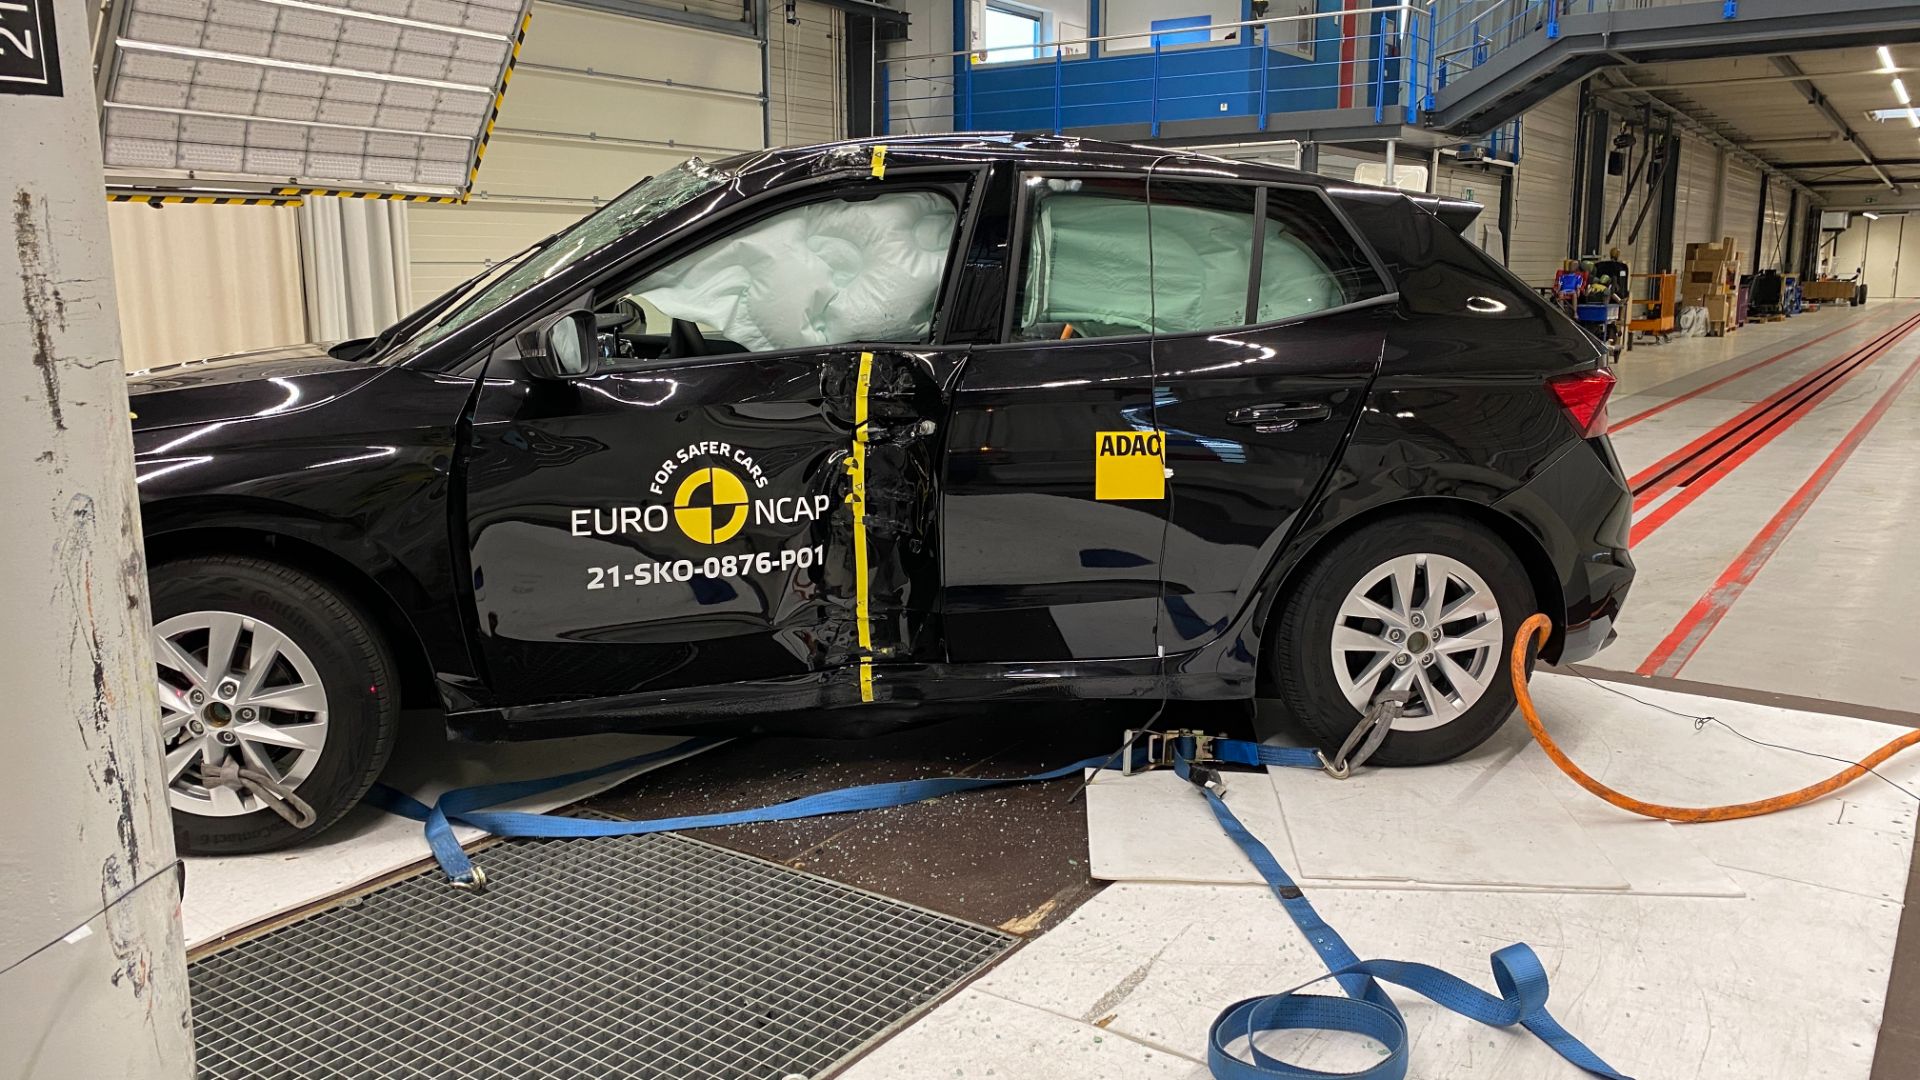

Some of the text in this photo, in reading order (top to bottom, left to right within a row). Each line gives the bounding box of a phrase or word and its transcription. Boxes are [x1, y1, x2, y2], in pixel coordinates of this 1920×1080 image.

[1100, 434, 1161, 456] ADAC
[650, 441, 768, 494] FOR SAFER CARS
[571, 494, 830, 537] EURO NCAP
[587, 545, 824, 590] 21-SKO-0876-P01
